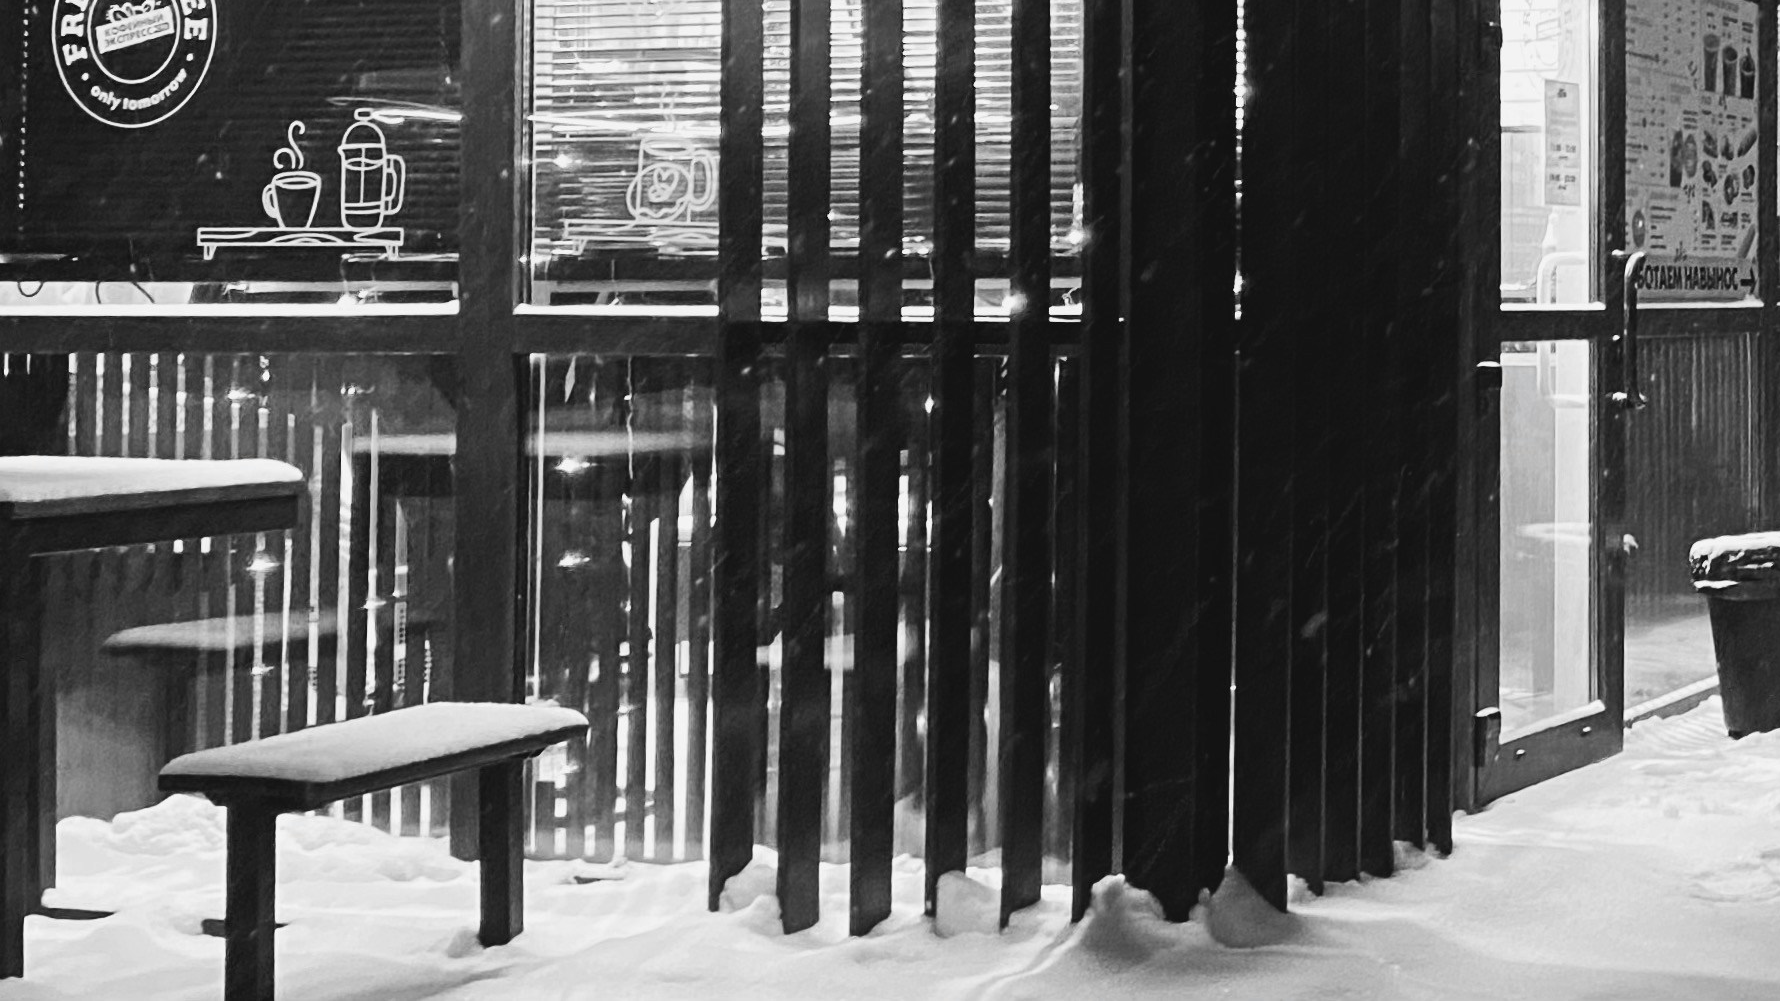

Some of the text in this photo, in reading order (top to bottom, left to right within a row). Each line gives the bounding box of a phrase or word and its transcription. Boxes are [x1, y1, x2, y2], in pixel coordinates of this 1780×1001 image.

[90, 68, 187, 111] only tomorrow
[1684, 265, 1738, 290] НАВЫНОС
